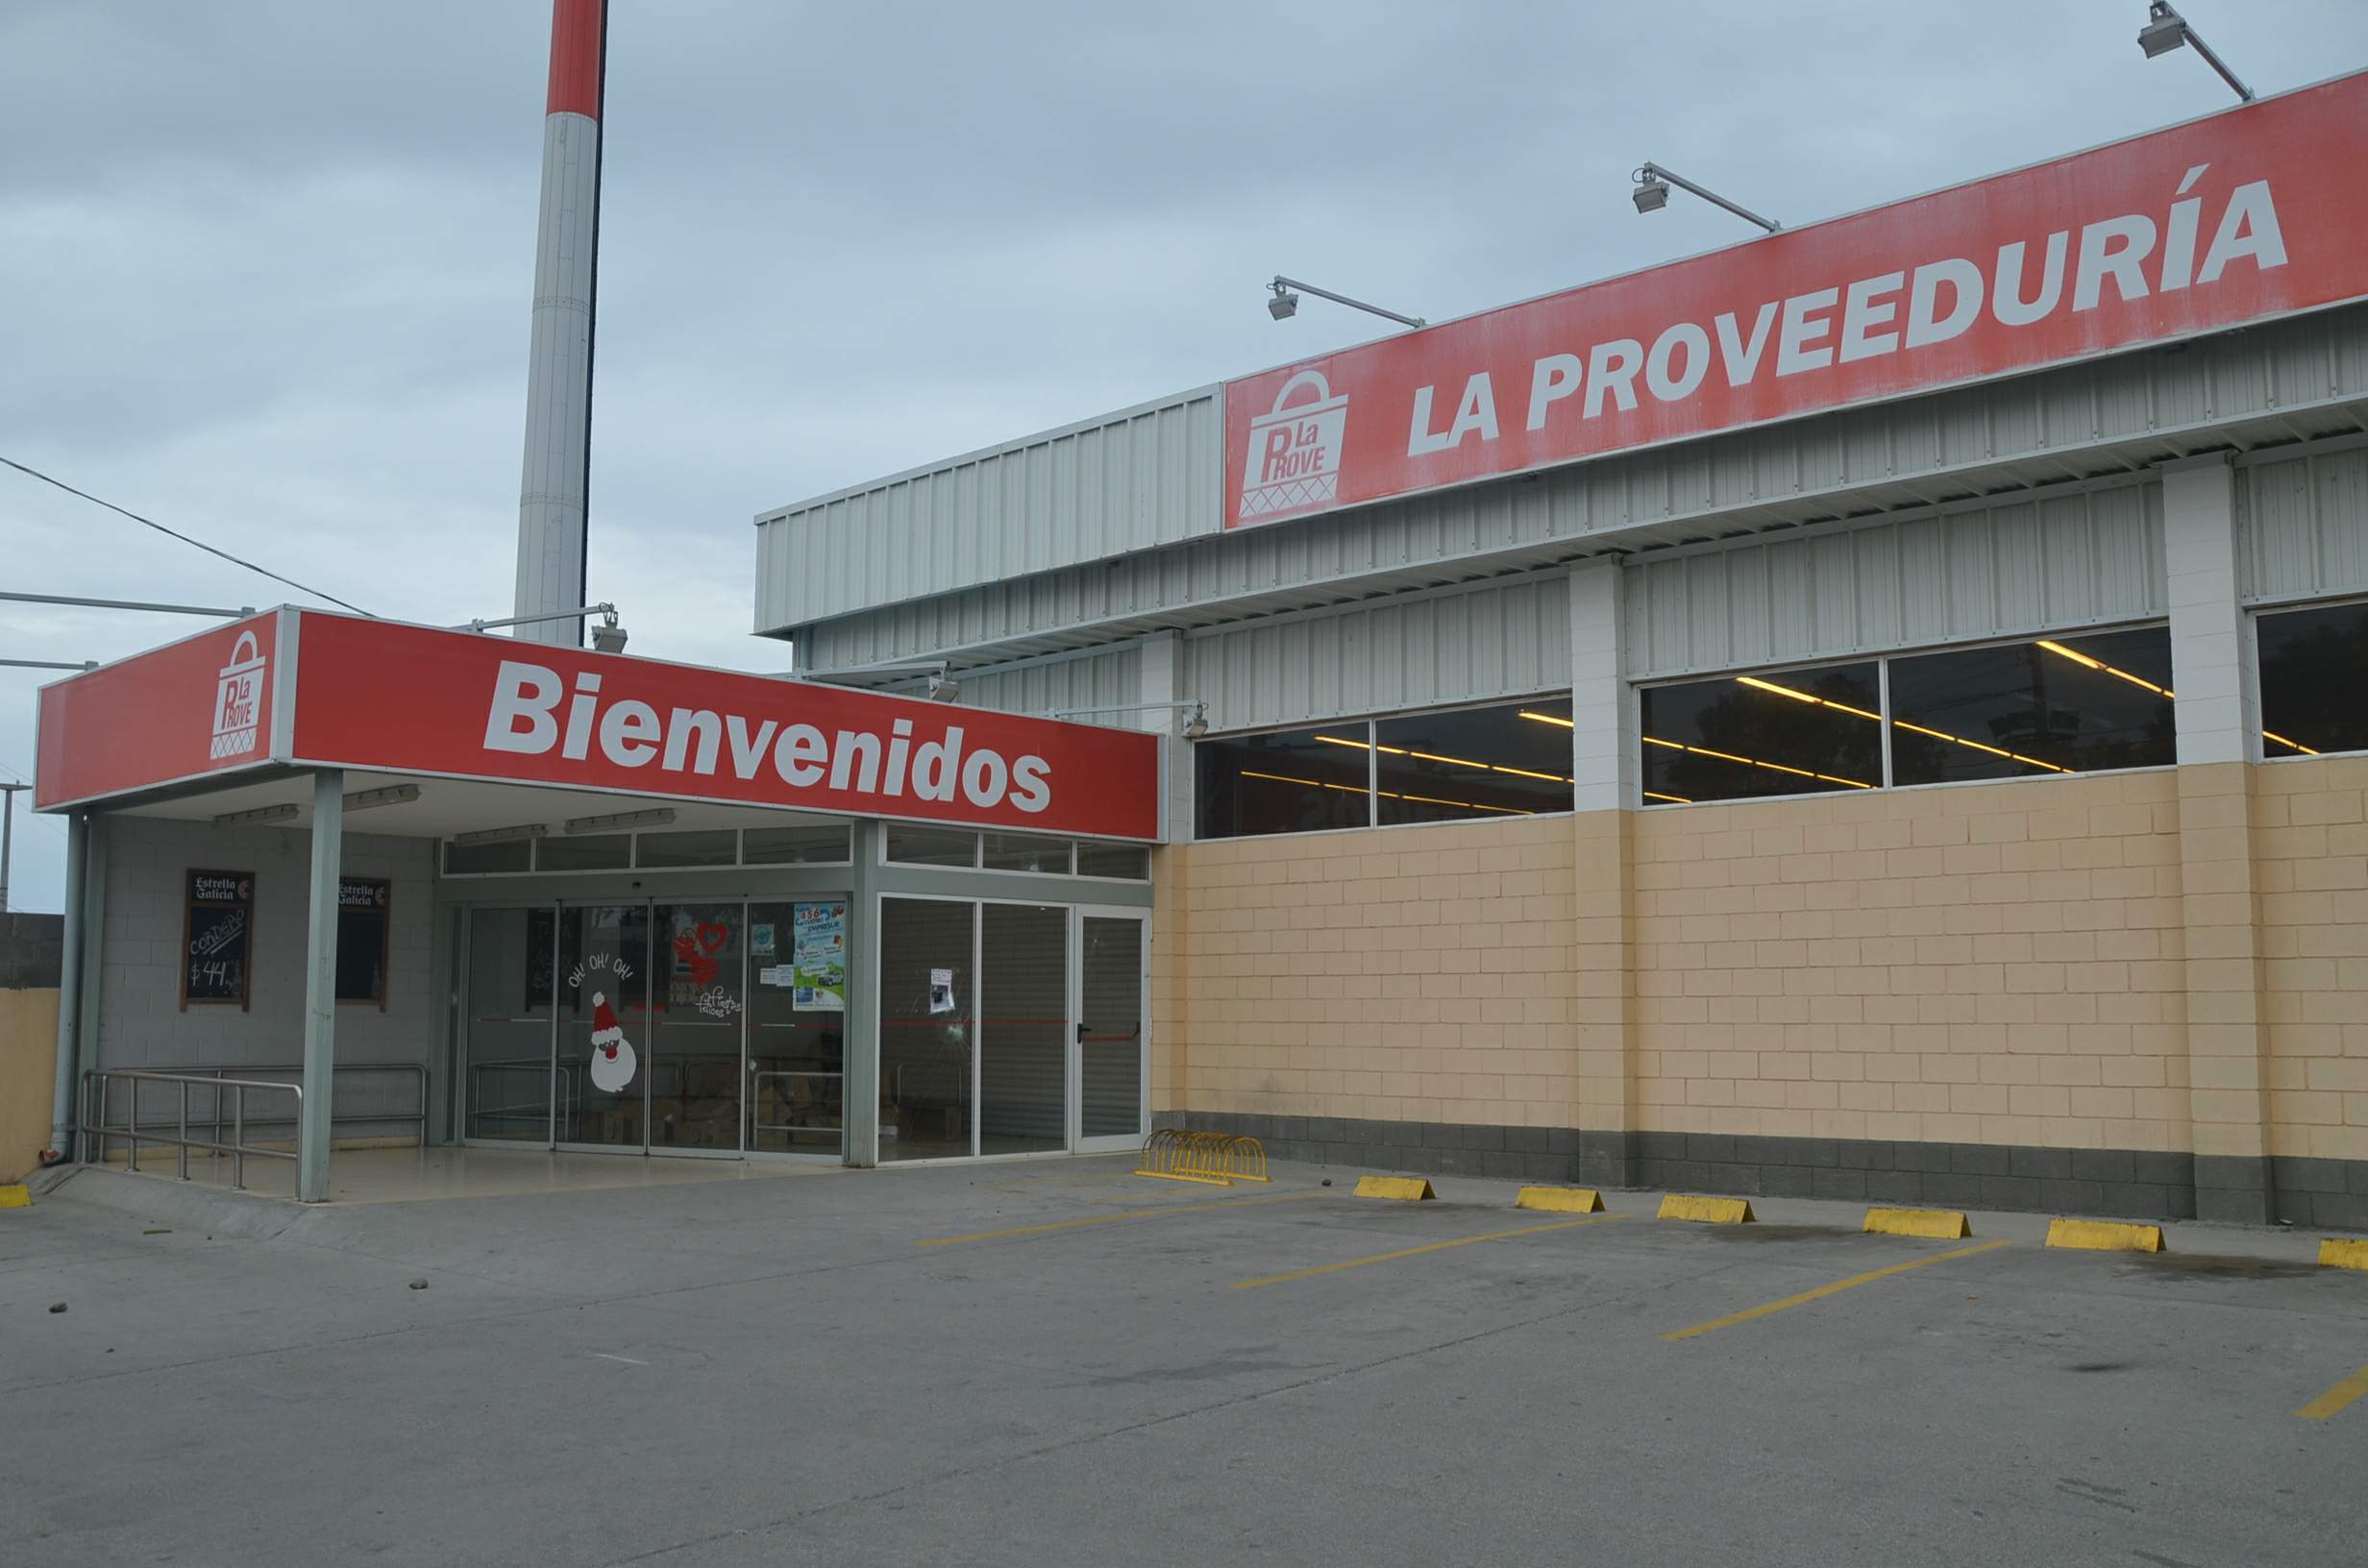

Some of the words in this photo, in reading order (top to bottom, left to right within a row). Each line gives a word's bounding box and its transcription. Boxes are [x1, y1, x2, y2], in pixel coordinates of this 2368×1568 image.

[1407, 371, 1500, 459] LA
[1527, 162, 2289, 432] PROVEEDURÍA
[1295, 421, 1319, 449] La
[238, 676, 251, 700] La
[483, 660, 1051, 814] Bienvenidos
[195, 876, 236, 890] Estrella
[196, 888, 234, 900] Galicia
[568, 963, 586, 988] OH!
[589, 953, 608, 969] OH!
[613, 958, 633, 980] OH!
